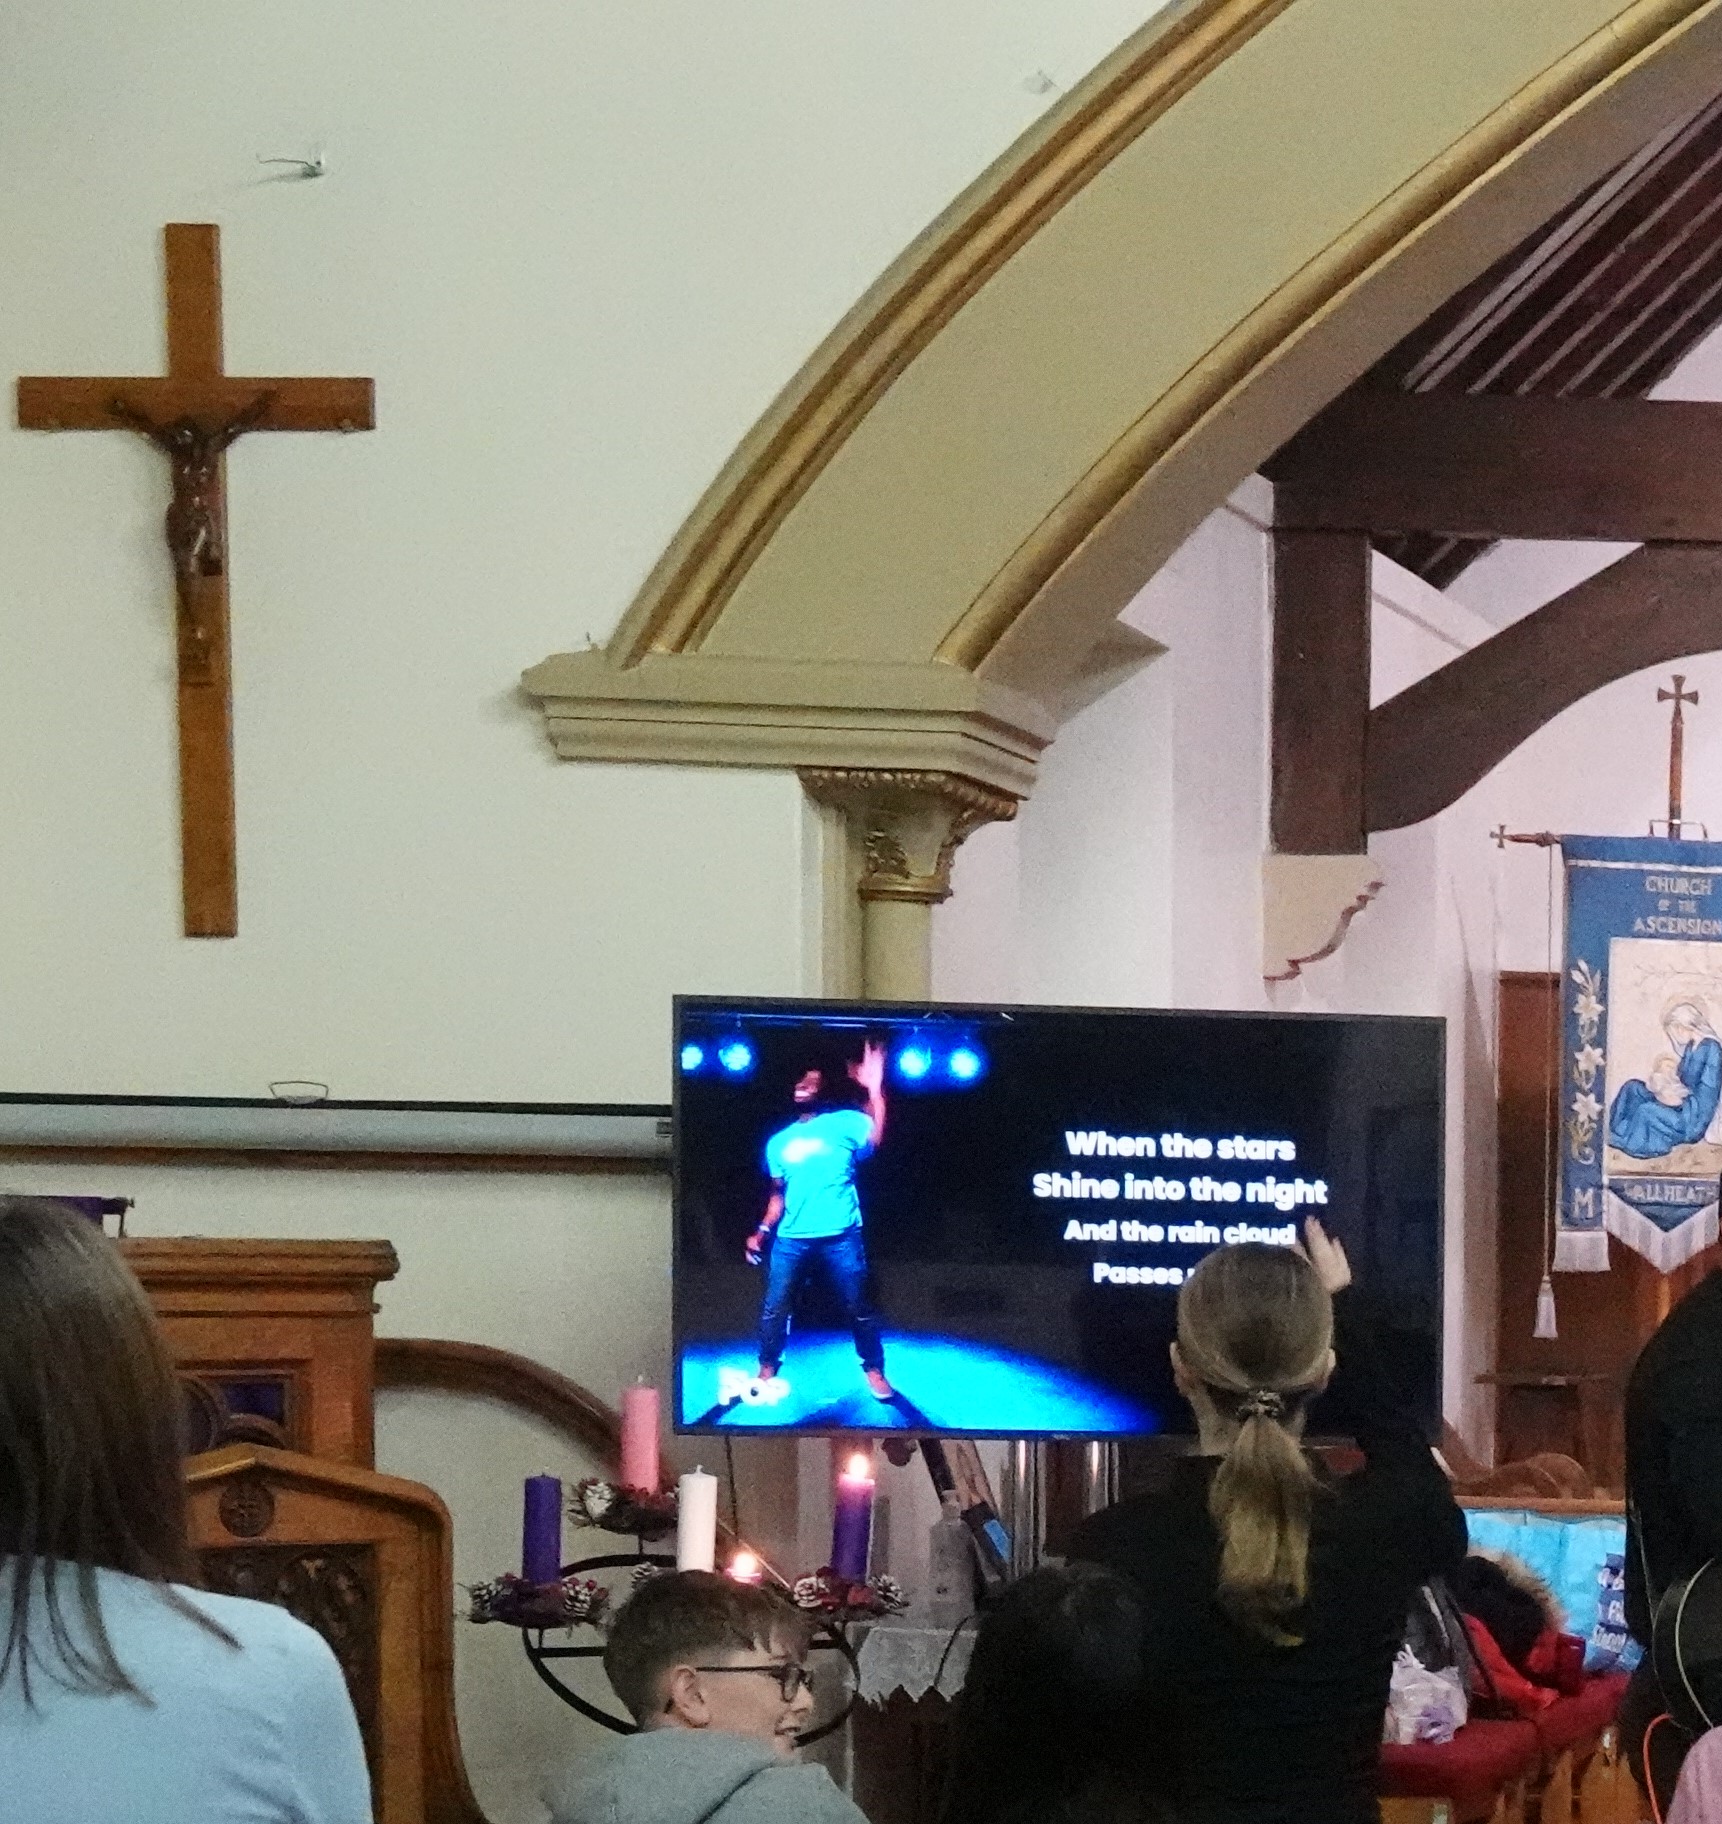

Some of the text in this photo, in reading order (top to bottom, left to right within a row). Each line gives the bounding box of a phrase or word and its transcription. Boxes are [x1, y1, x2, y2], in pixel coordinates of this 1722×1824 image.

[1645, 875, 1713, 896] CHURCH
[1065, 1131, 1297, 1161] When the stars
[1033, 1171, 1329, 1211] Shine into the night
[1063, 1219, 1297, 1245] And the rain cloud
[1093, 1262, 1184, 1285] Passes
